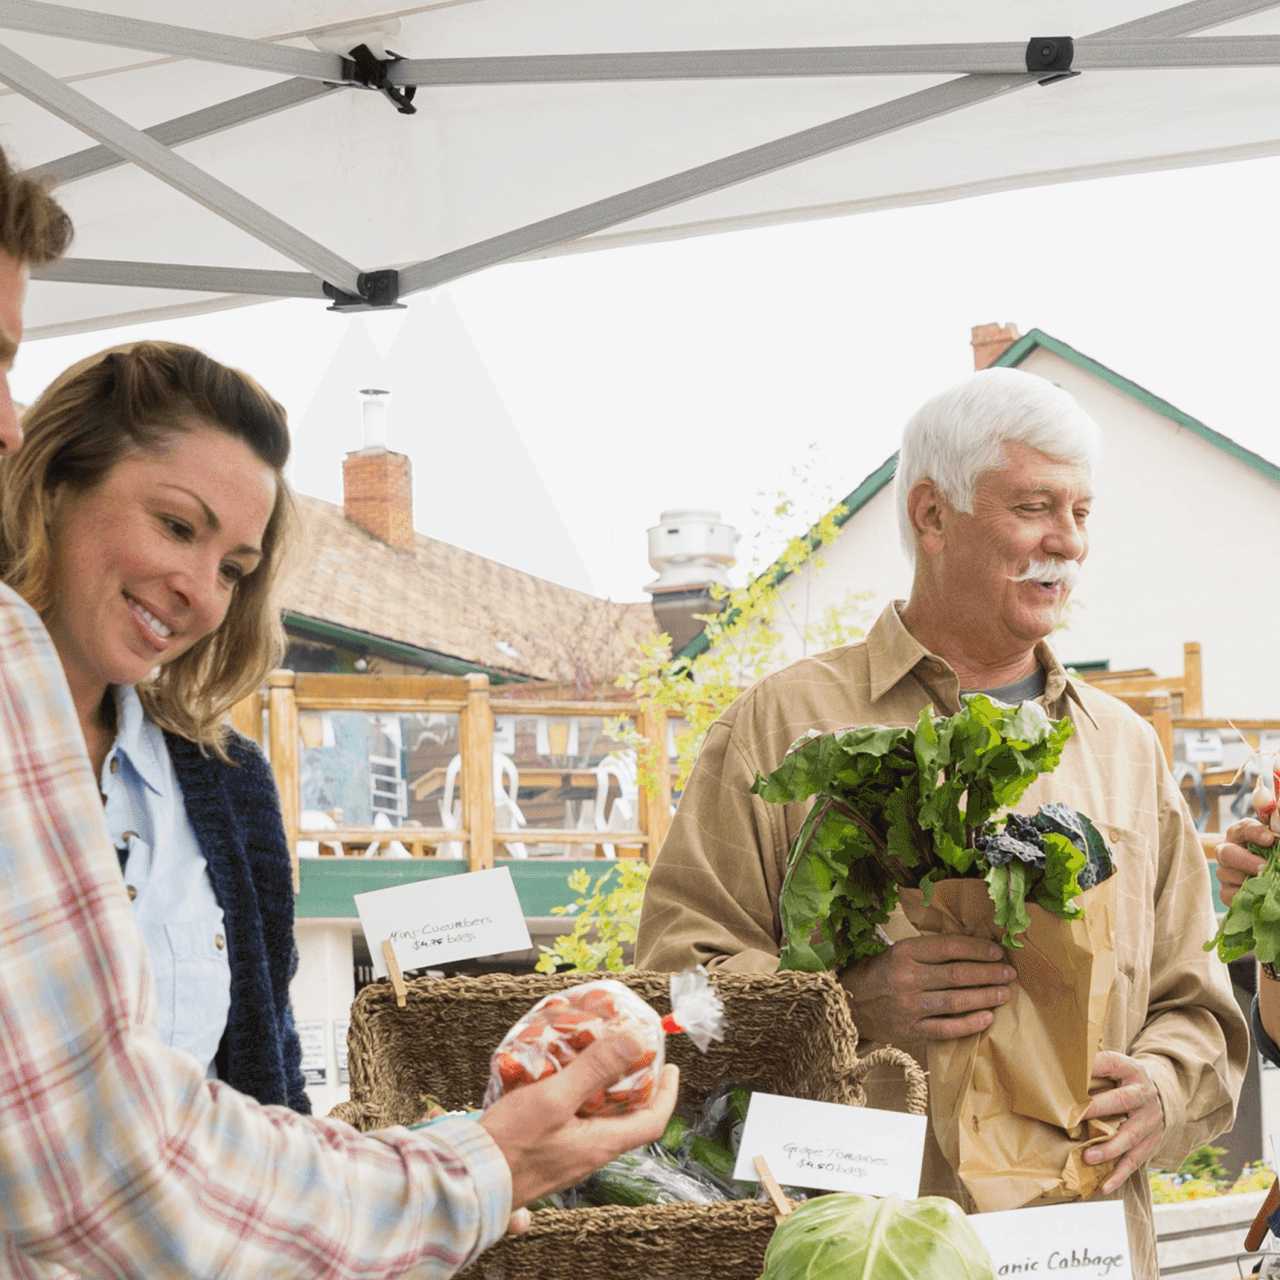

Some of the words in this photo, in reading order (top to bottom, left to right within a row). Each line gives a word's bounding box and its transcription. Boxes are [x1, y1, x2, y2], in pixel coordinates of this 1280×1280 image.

[388, 916, 493, 940] Mini-Cucumbers
[447, 931, 477, 944] bags
[782, 1142, 823, 1160] Grape
[836, 1163, 868, 1177] bags
[1047, 1248, 1124, 1277] Cabbage
